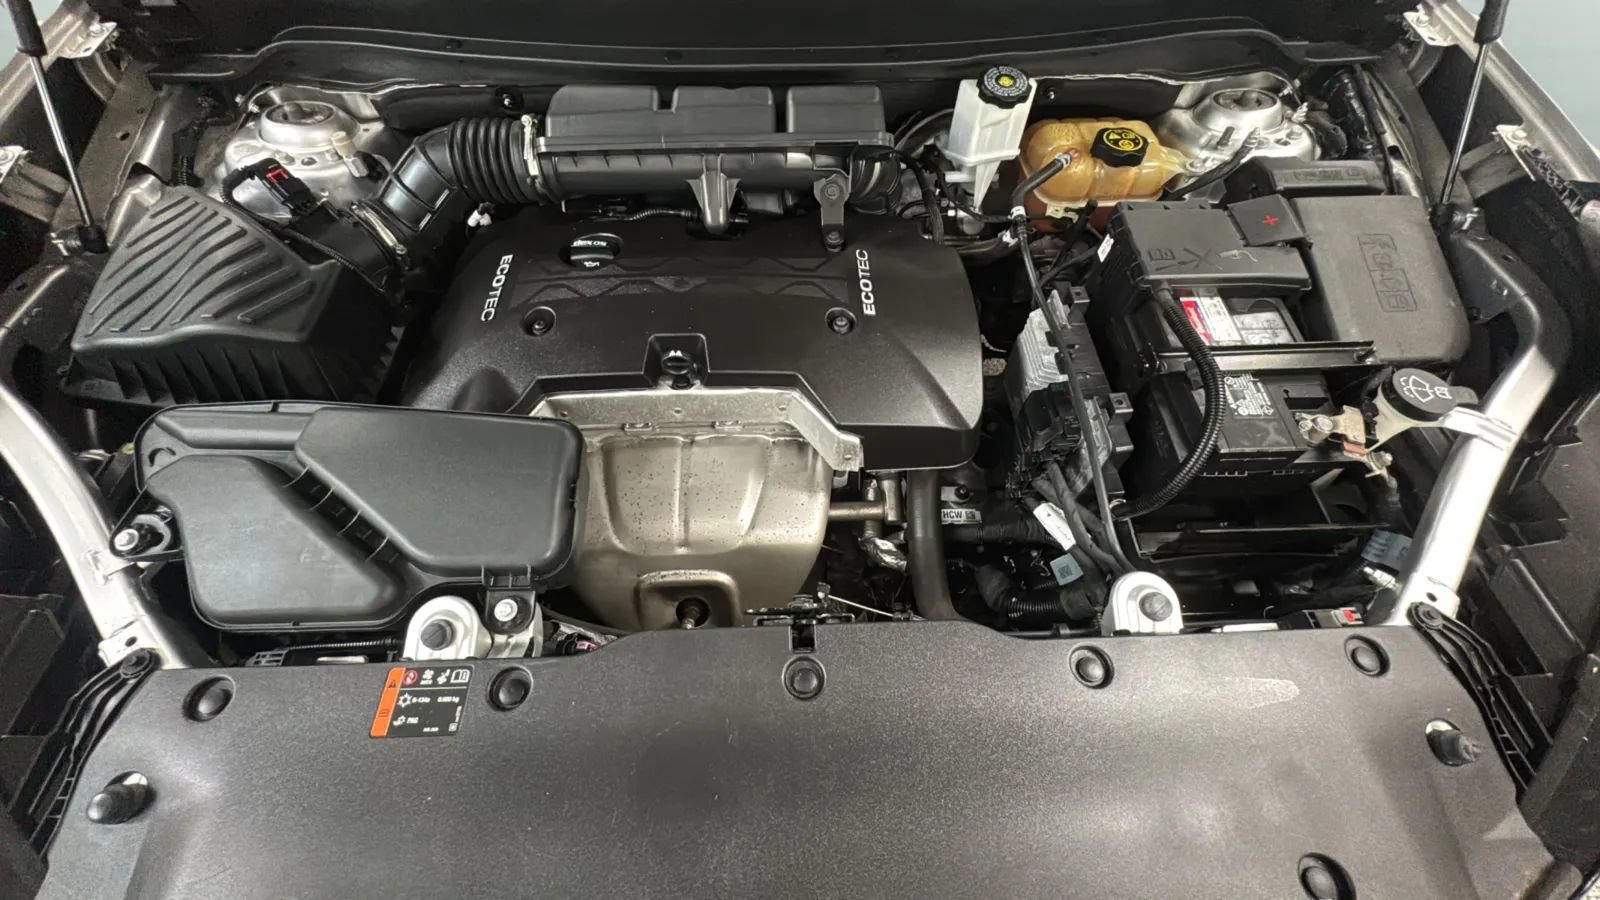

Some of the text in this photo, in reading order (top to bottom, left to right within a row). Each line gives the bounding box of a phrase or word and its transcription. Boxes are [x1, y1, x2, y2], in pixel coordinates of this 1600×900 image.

[481, 254, 514, 322] ECOTEC
[856, 249, 876, 316] ECOTEC
[943, 510, 963, 519] HCW
